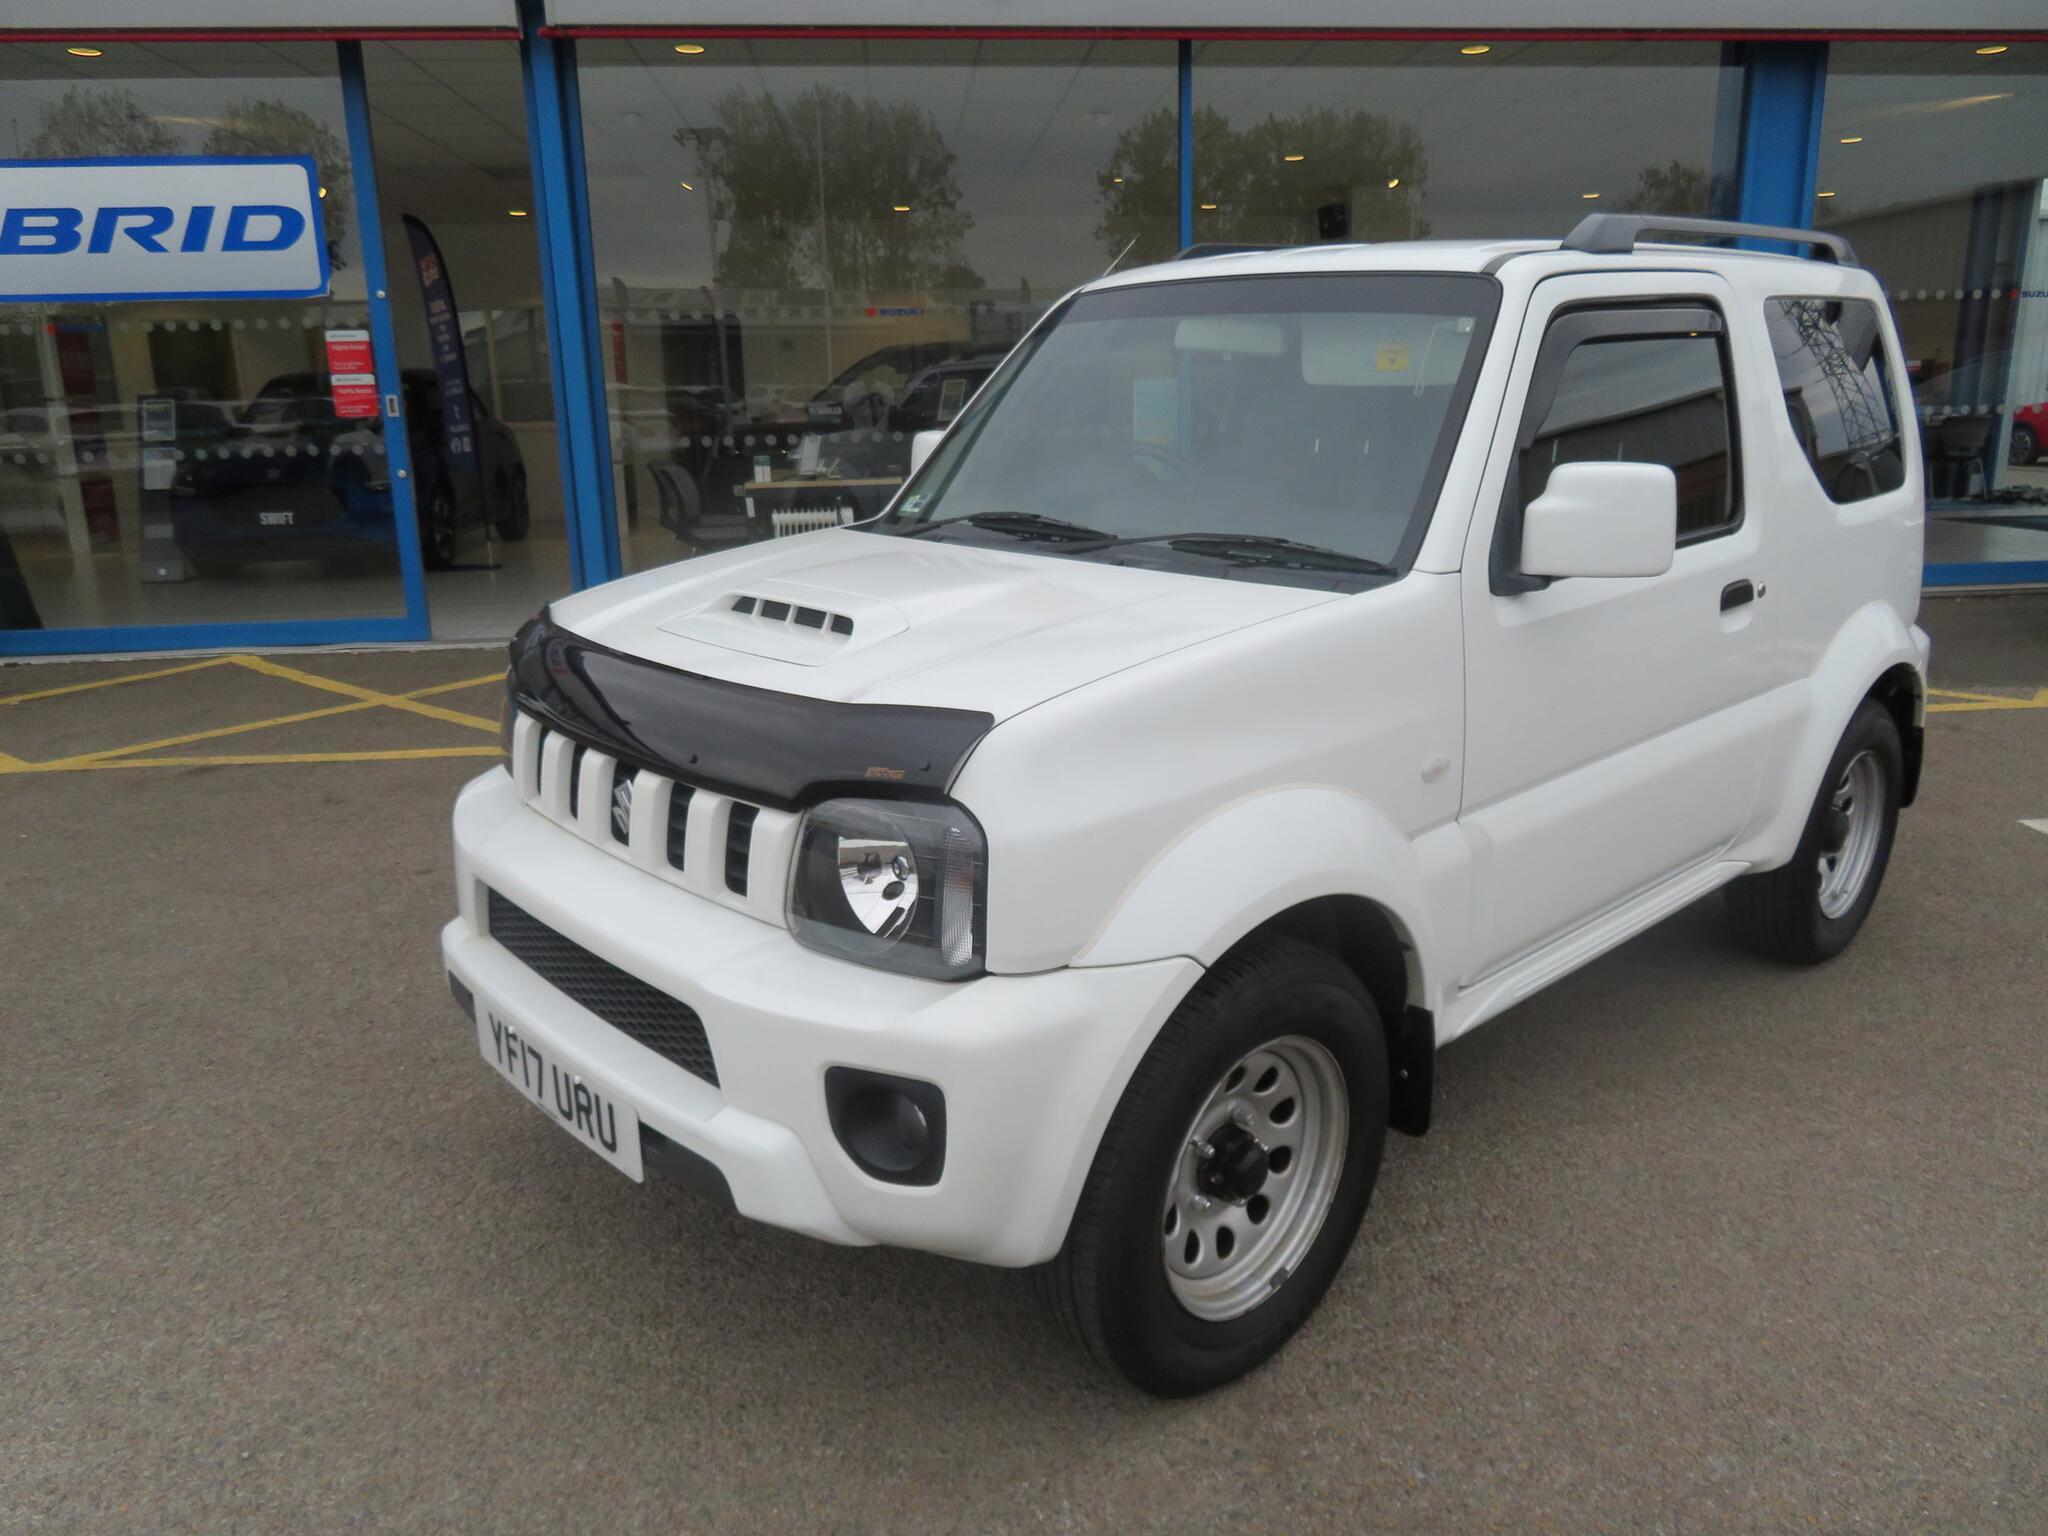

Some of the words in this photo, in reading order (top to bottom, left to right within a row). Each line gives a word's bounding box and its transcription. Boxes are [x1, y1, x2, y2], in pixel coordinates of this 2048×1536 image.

[0, 205, 306, 255] BRID
[880, 307, 924, 317] SUZUKI
[260, 512, 294, 525] SWIFT
[489, 1012, 543, 1099] YF17
[553, 1063, 617, 1153] URU
